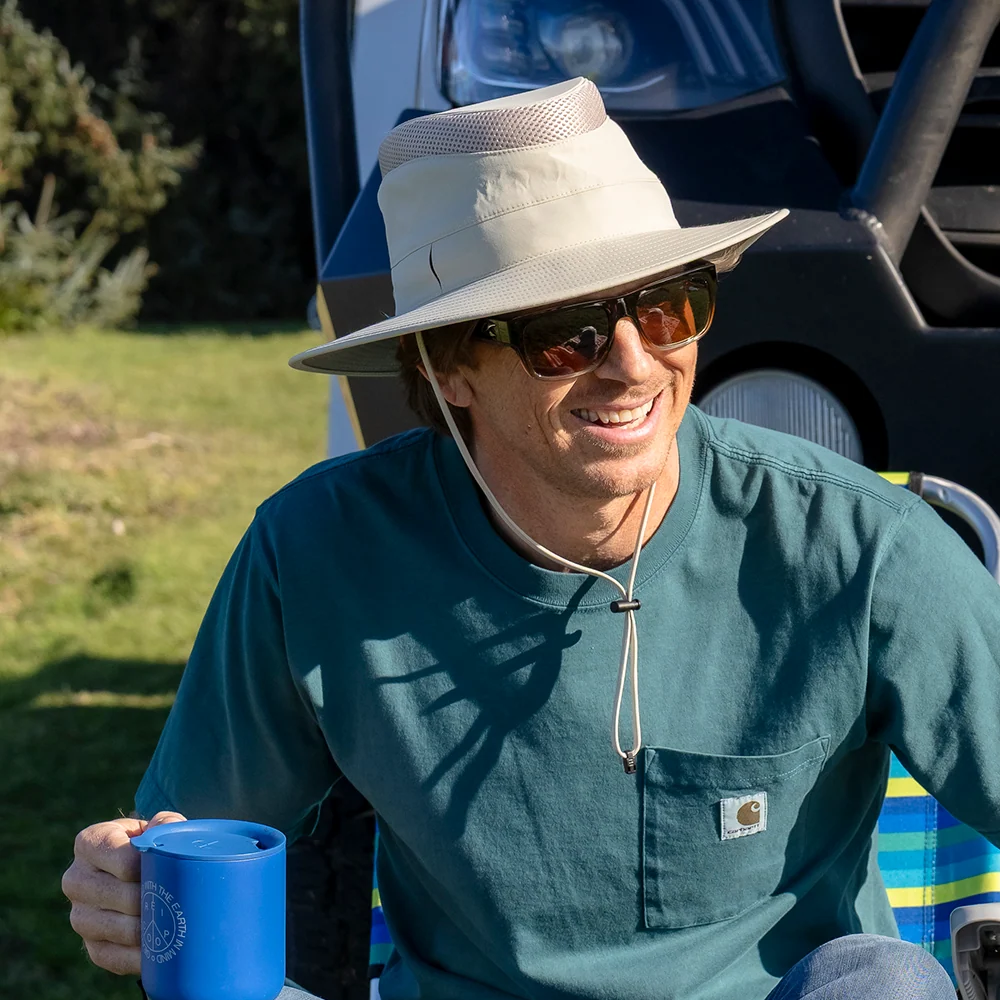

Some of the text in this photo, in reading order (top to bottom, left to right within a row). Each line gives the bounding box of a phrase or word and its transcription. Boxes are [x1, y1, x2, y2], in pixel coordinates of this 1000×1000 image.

[158, 884, 174, 904] THE
[171, 902, 187, 938] EARTH
[173, 938, 185, 951] IN
